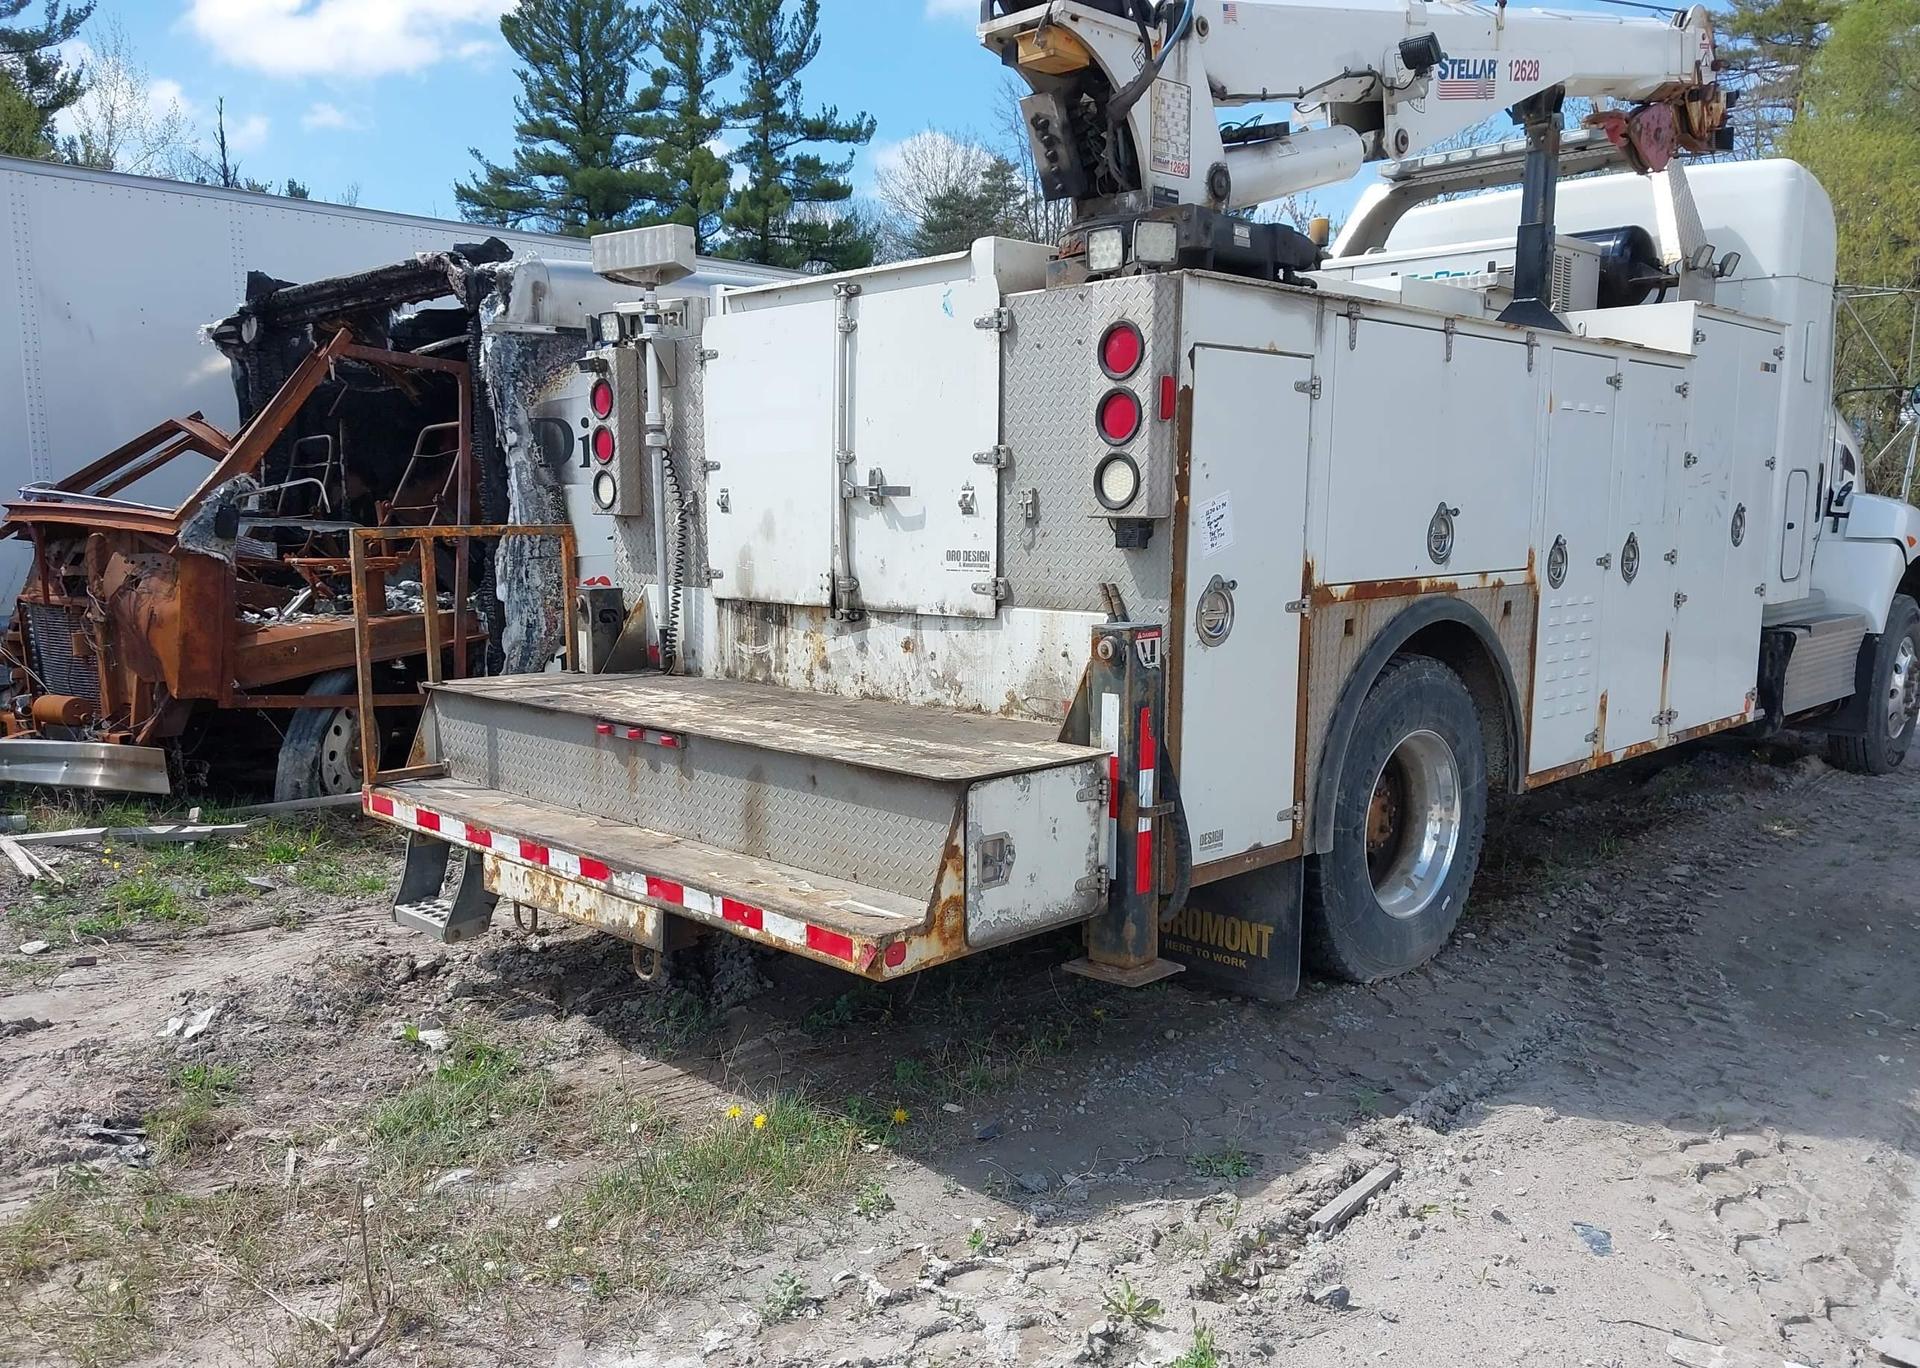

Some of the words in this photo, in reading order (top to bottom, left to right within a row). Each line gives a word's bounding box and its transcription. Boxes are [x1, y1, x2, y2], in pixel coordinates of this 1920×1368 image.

[1438, 55, 1497, 80] STELLAR
[1508, 60, 1540, 81] 12628
[946, 550, 961, 562] ORO
[962, 550, 990, 562] DESIGN
[1199, 829, 1224, 846] DESIGN
[1165, 938, 1193, 954] HERE
[1196, 947, 1210, 959] TO
[1212, 951, 1247, 969] WORK
